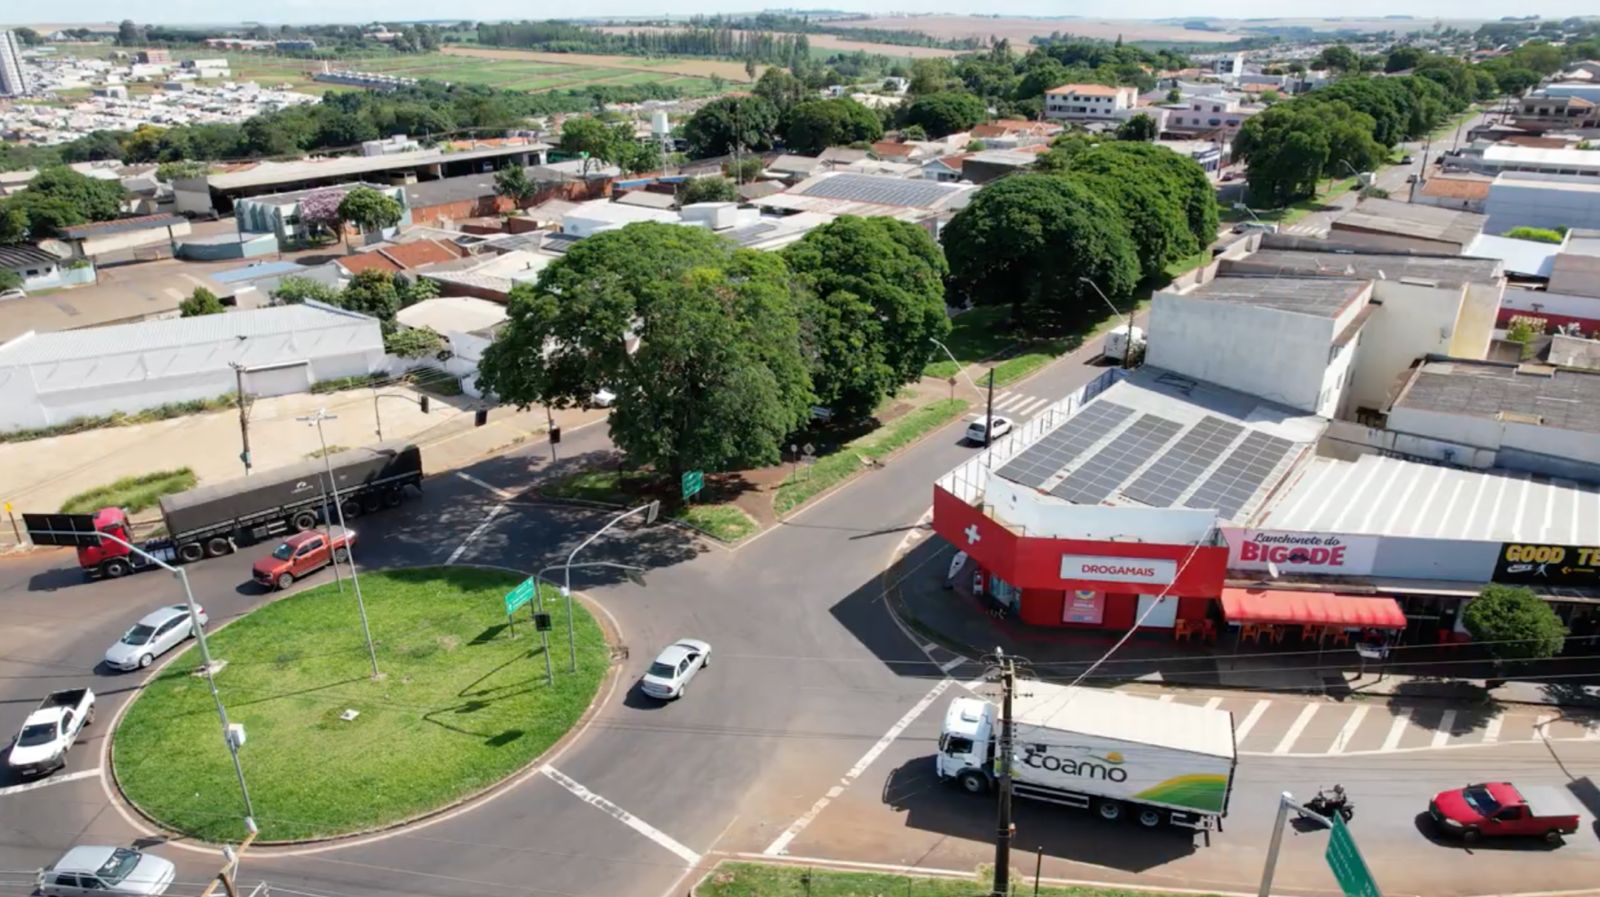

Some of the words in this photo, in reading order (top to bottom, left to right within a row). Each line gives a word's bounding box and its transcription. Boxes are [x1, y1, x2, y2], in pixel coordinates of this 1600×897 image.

[1254, 532, 1322, 545] Lanchonete
[1324, 536, 1340, 546] do
[1240, 541, 1347, 566] BIGODE
[1506, 544, 1566, 564] GOOD
[1082, 564, 1155, 577] DROGAMAIS
[1028, 753, 1128, 783] coamo
